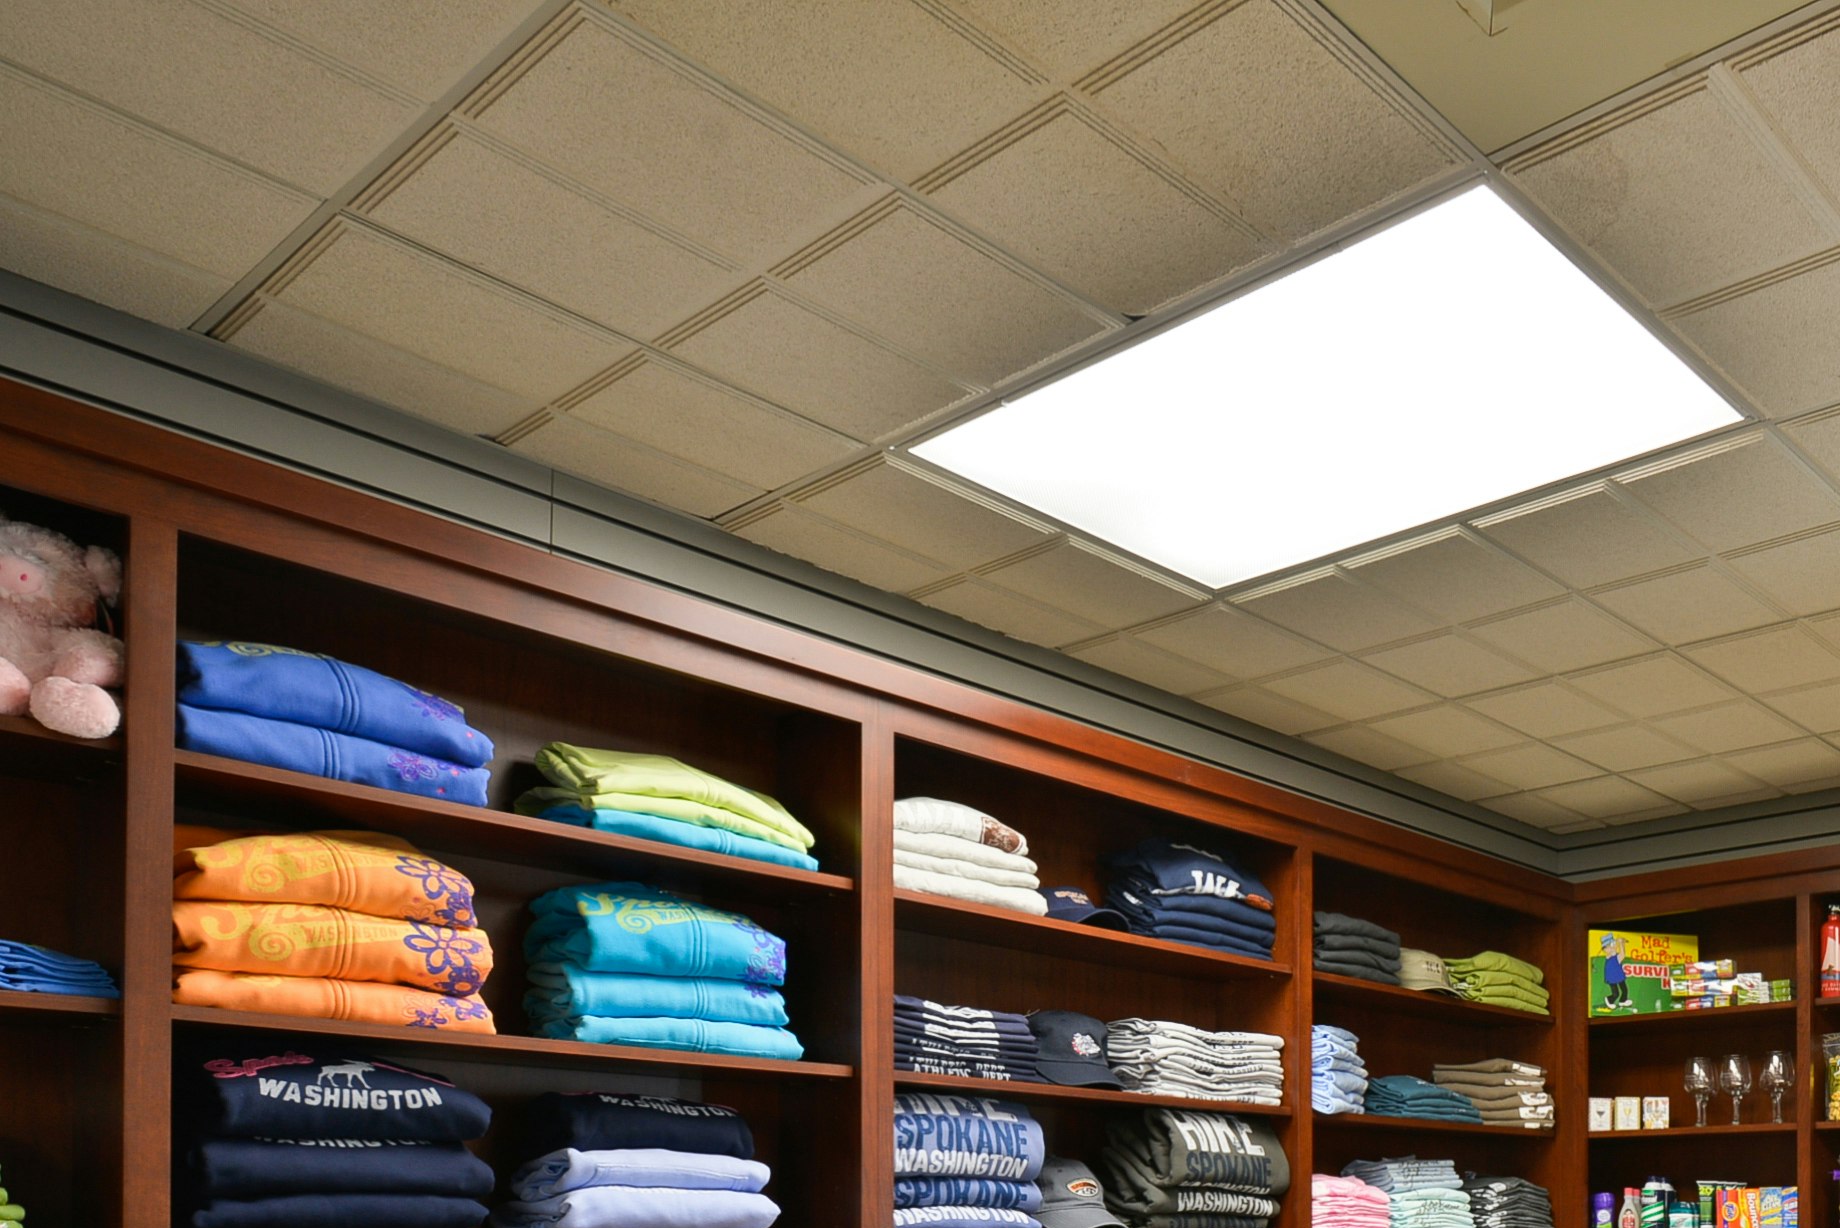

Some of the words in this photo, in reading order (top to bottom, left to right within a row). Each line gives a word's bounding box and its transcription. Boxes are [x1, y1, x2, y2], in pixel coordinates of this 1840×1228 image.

[305, 926, 399, 943] WASINGTON
[1641, 935, 1670, 949] Mad
[1630, 948, 1693, 964] Golfer's
[1623, 965, 1669, 977] SURVI
[257, 1077, 443, 1111] WASHINGTON
[599, 1094, 737, 1117] WASHINGTON
[894, 1114, 1028, 1159] SPOKANE
[894, 1148, 1028, 1179] WASHINGTON
[1185, 1151, 1272, 1185] SPOKANE
[1177, 1191, 1273, 1216] WASHINGTON
[1725, 1204, 1737, 1219] Tide
